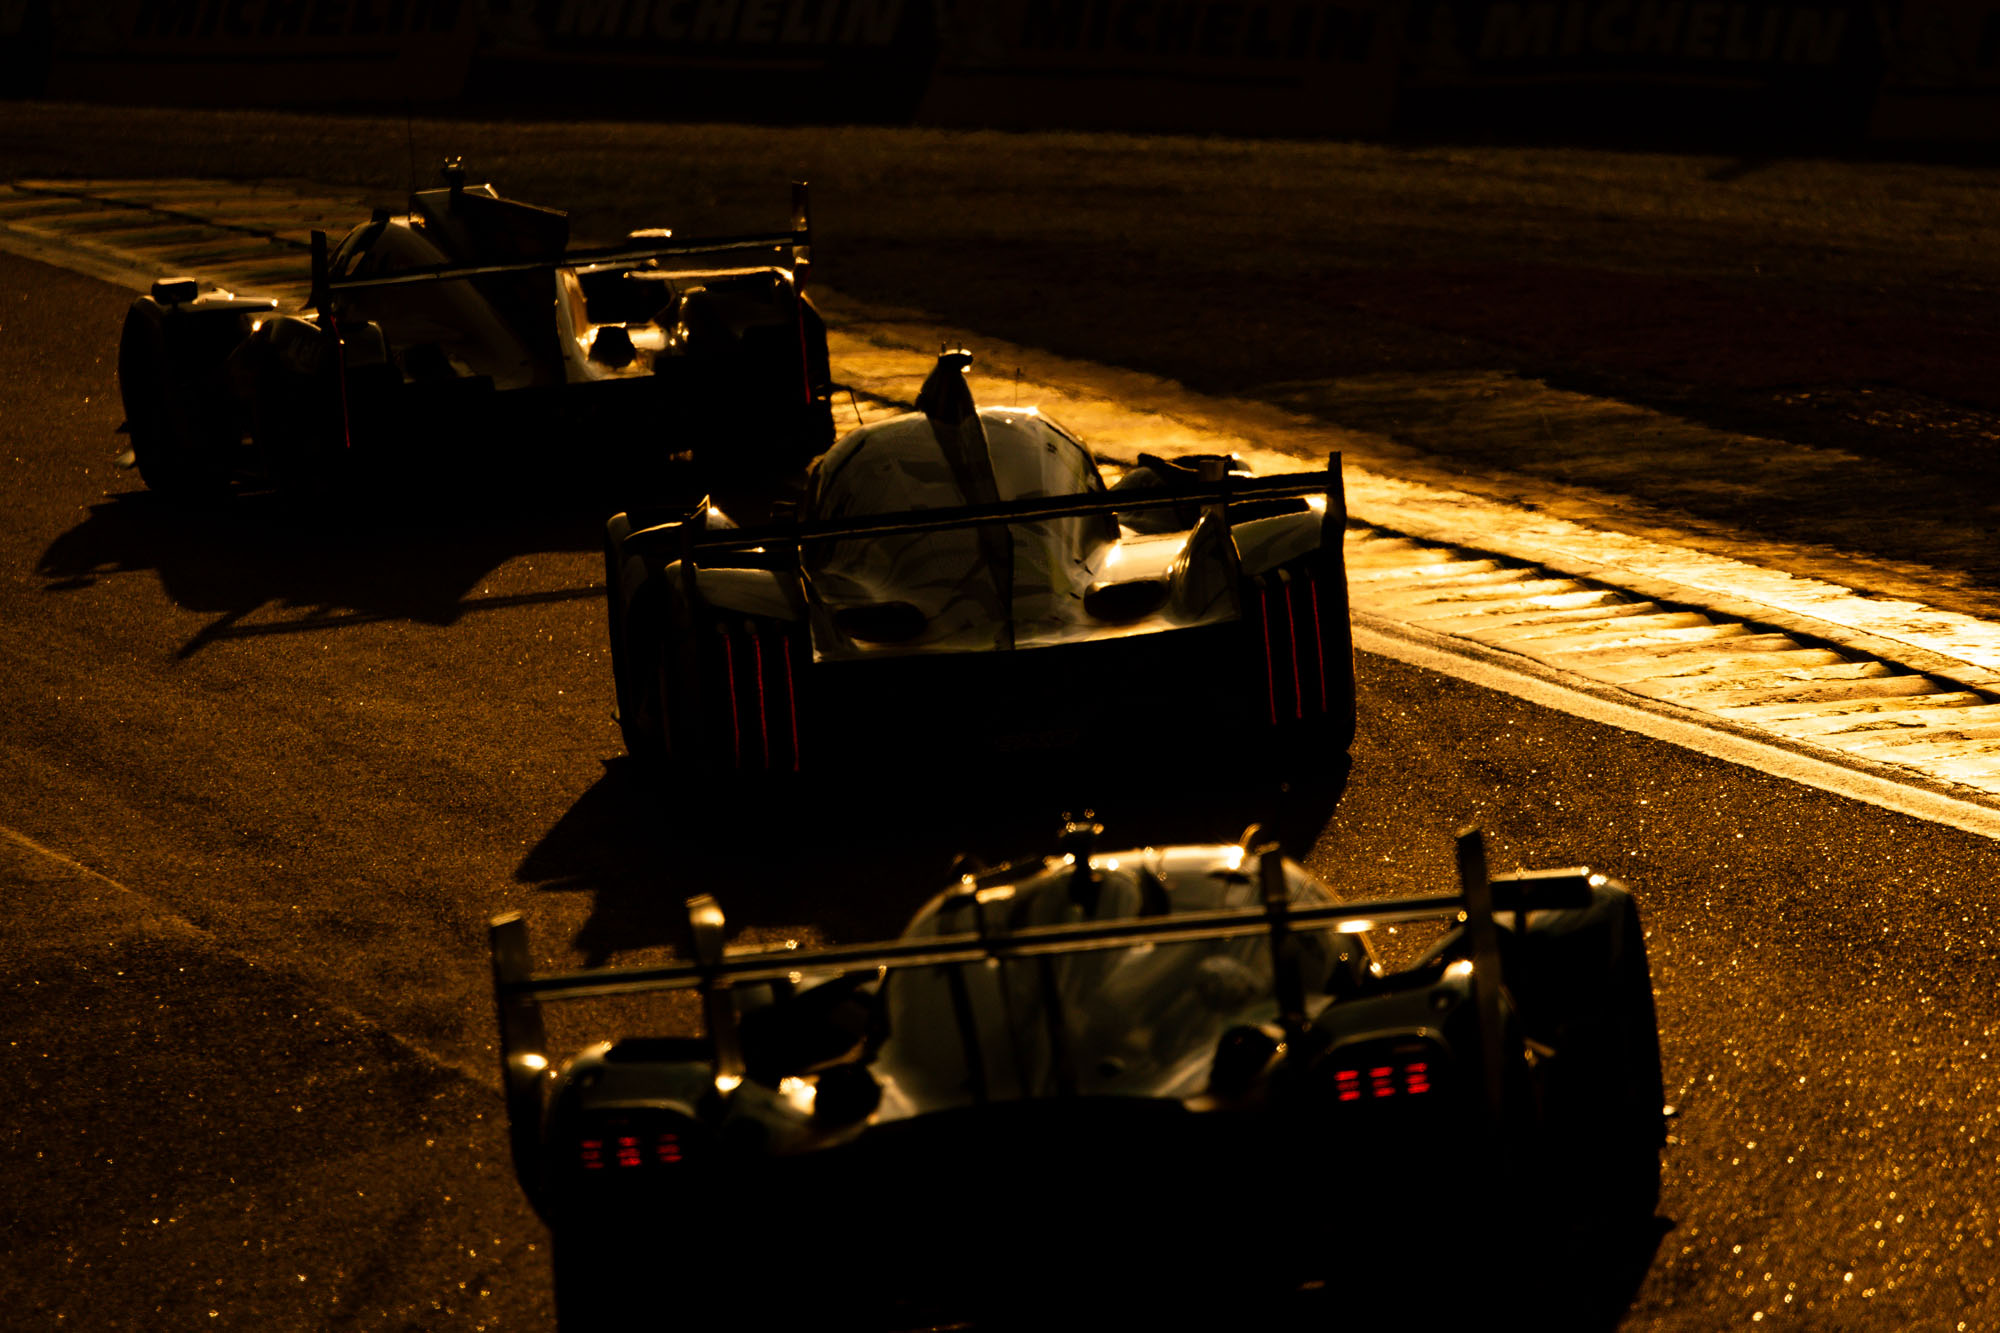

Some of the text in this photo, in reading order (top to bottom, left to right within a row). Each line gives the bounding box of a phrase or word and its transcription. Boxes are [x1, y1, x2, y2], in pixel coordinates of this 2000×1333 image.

[131, 0, 463, 38] MICHELIN
[552, 0, 904, 47] MICHELIN
[1020, 0, 1377, 63] MICHELIN
[1475, 0, 1850, 64] MICHELIN
